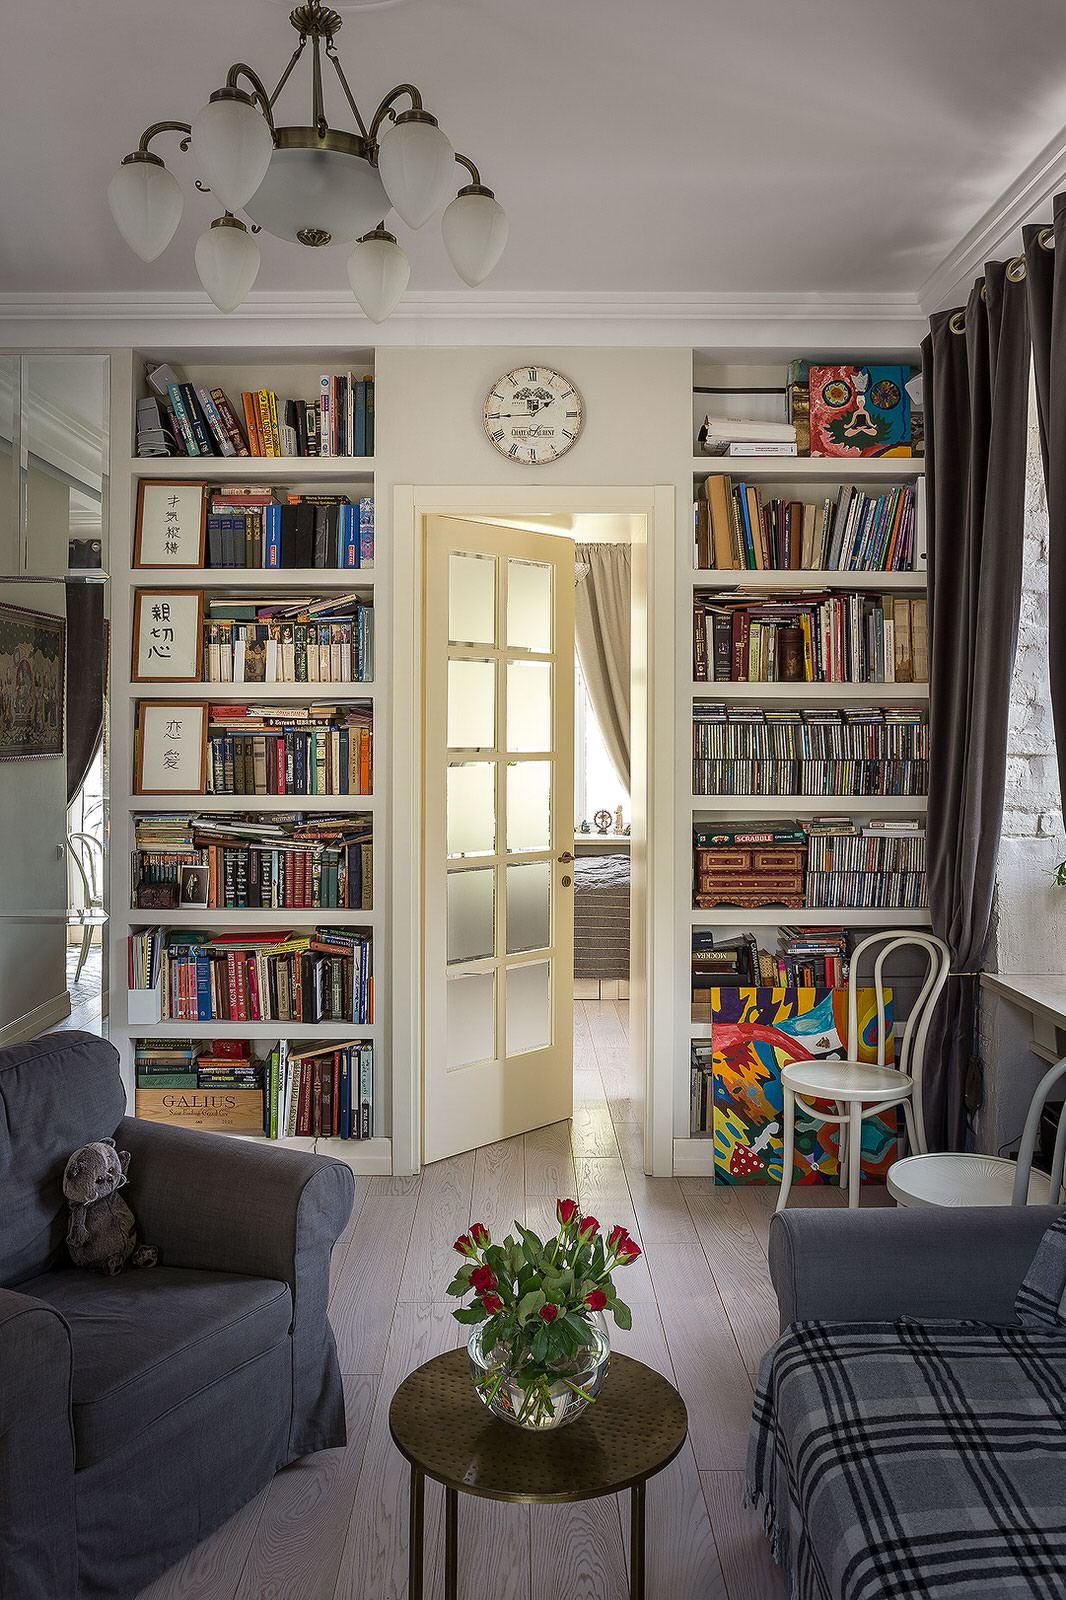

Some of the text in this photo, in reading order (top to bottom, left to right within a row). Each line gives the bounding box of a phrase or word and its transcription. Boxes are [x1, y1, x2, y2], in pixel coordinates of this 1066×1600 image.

[147, 602, 174, 659] 親切心
[735, 834, 773, 843] SCRABBLE
[162, 1095, 237, 1109] GALIUS
